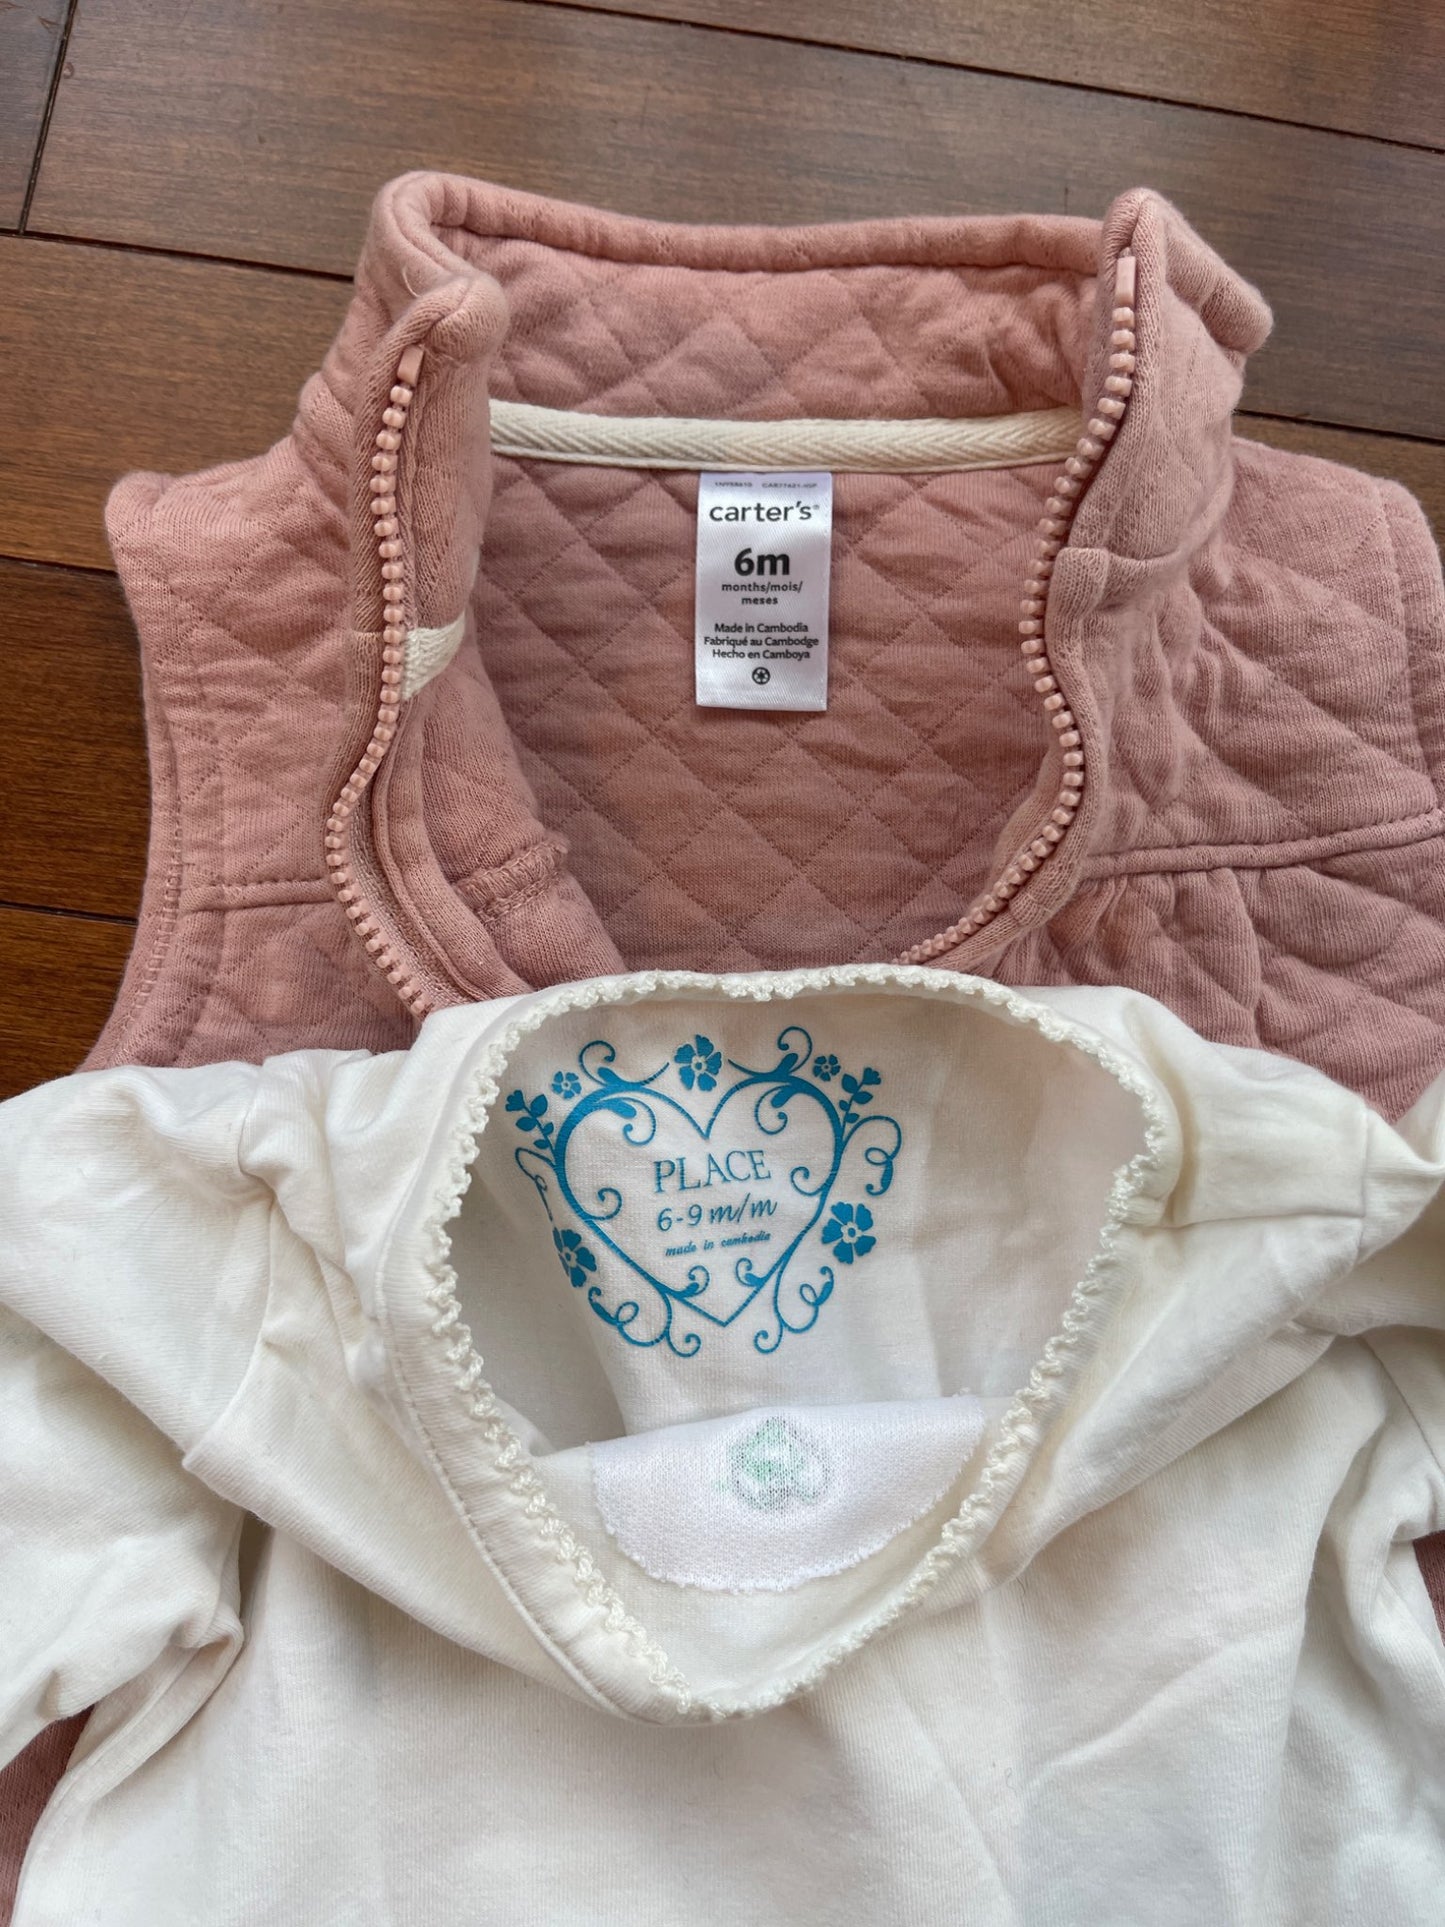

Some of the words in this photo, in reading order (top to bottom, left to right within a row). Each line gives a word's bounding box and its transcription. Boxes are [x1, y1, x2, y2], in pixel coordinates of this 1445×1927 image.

[734, 547, 790, 576] 6m
[721, 581, 803, 594] months/mois/
[741, 597, 779, 605] meses
[714, 623, 743, 633] Made
[745, 623, 755, 633] in
[757, 622, 809, 633] Cambodia
[703, 636, 748, 648] Fabriqué
[750, 638, 763, 646] au
[764, 636, 819, 648] Cambodge
[712, 649, 745, 658] Hecho
[747, 651, 760, 659] en
[762, 649, 811, 661] Camboya
[653, 1149, 772, 1193] PLACE
[657, 1203, 703, 1232] 6-9
[710, 1192, 778, 1224] m/m
[665, 1240, 697, 1257] made
[703, 1239, 715, 1251] in
[721, 1230, 771, 1247] cambodia
